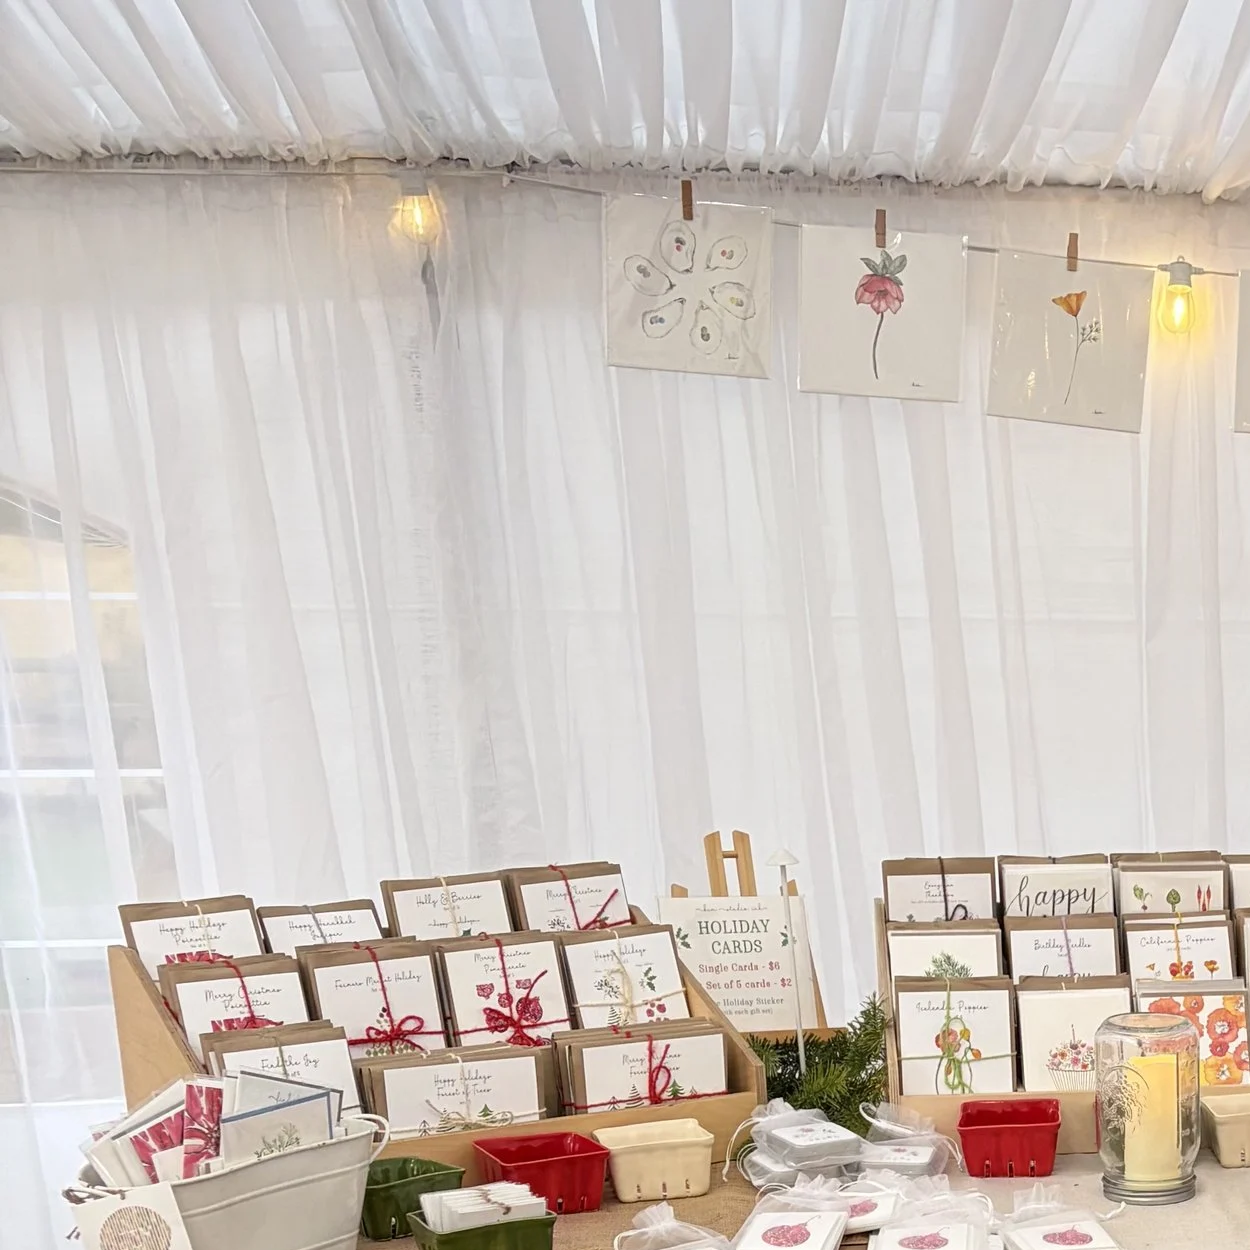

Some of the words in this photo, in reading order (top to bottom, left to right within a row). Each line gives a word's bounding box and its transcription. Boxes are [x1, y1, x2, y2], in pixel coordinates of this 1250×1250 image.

[416, 894, 438, 908] Holly
[451, 891, 481, 903] Berries
[1006, 876, 1108, 916] happy
[698, 919, 770, 935] HOLIDAY
[711, 939, 763, 955] CARDS
[699, 963, 728, 975] Single
[731, 962, 759, 972] Cards
[768, 961, 780, 972] $6
[395, 970, 422, 982] Holiday
[706, 980, 721, 990] Set
[723, 980, 734, 989] of
[745, 979, 771, 989] cards
[780, 977, 792, 988] $2
[723, 998, 753, 1007] Holiday
[437, 1087, 460, 1100] Forest
